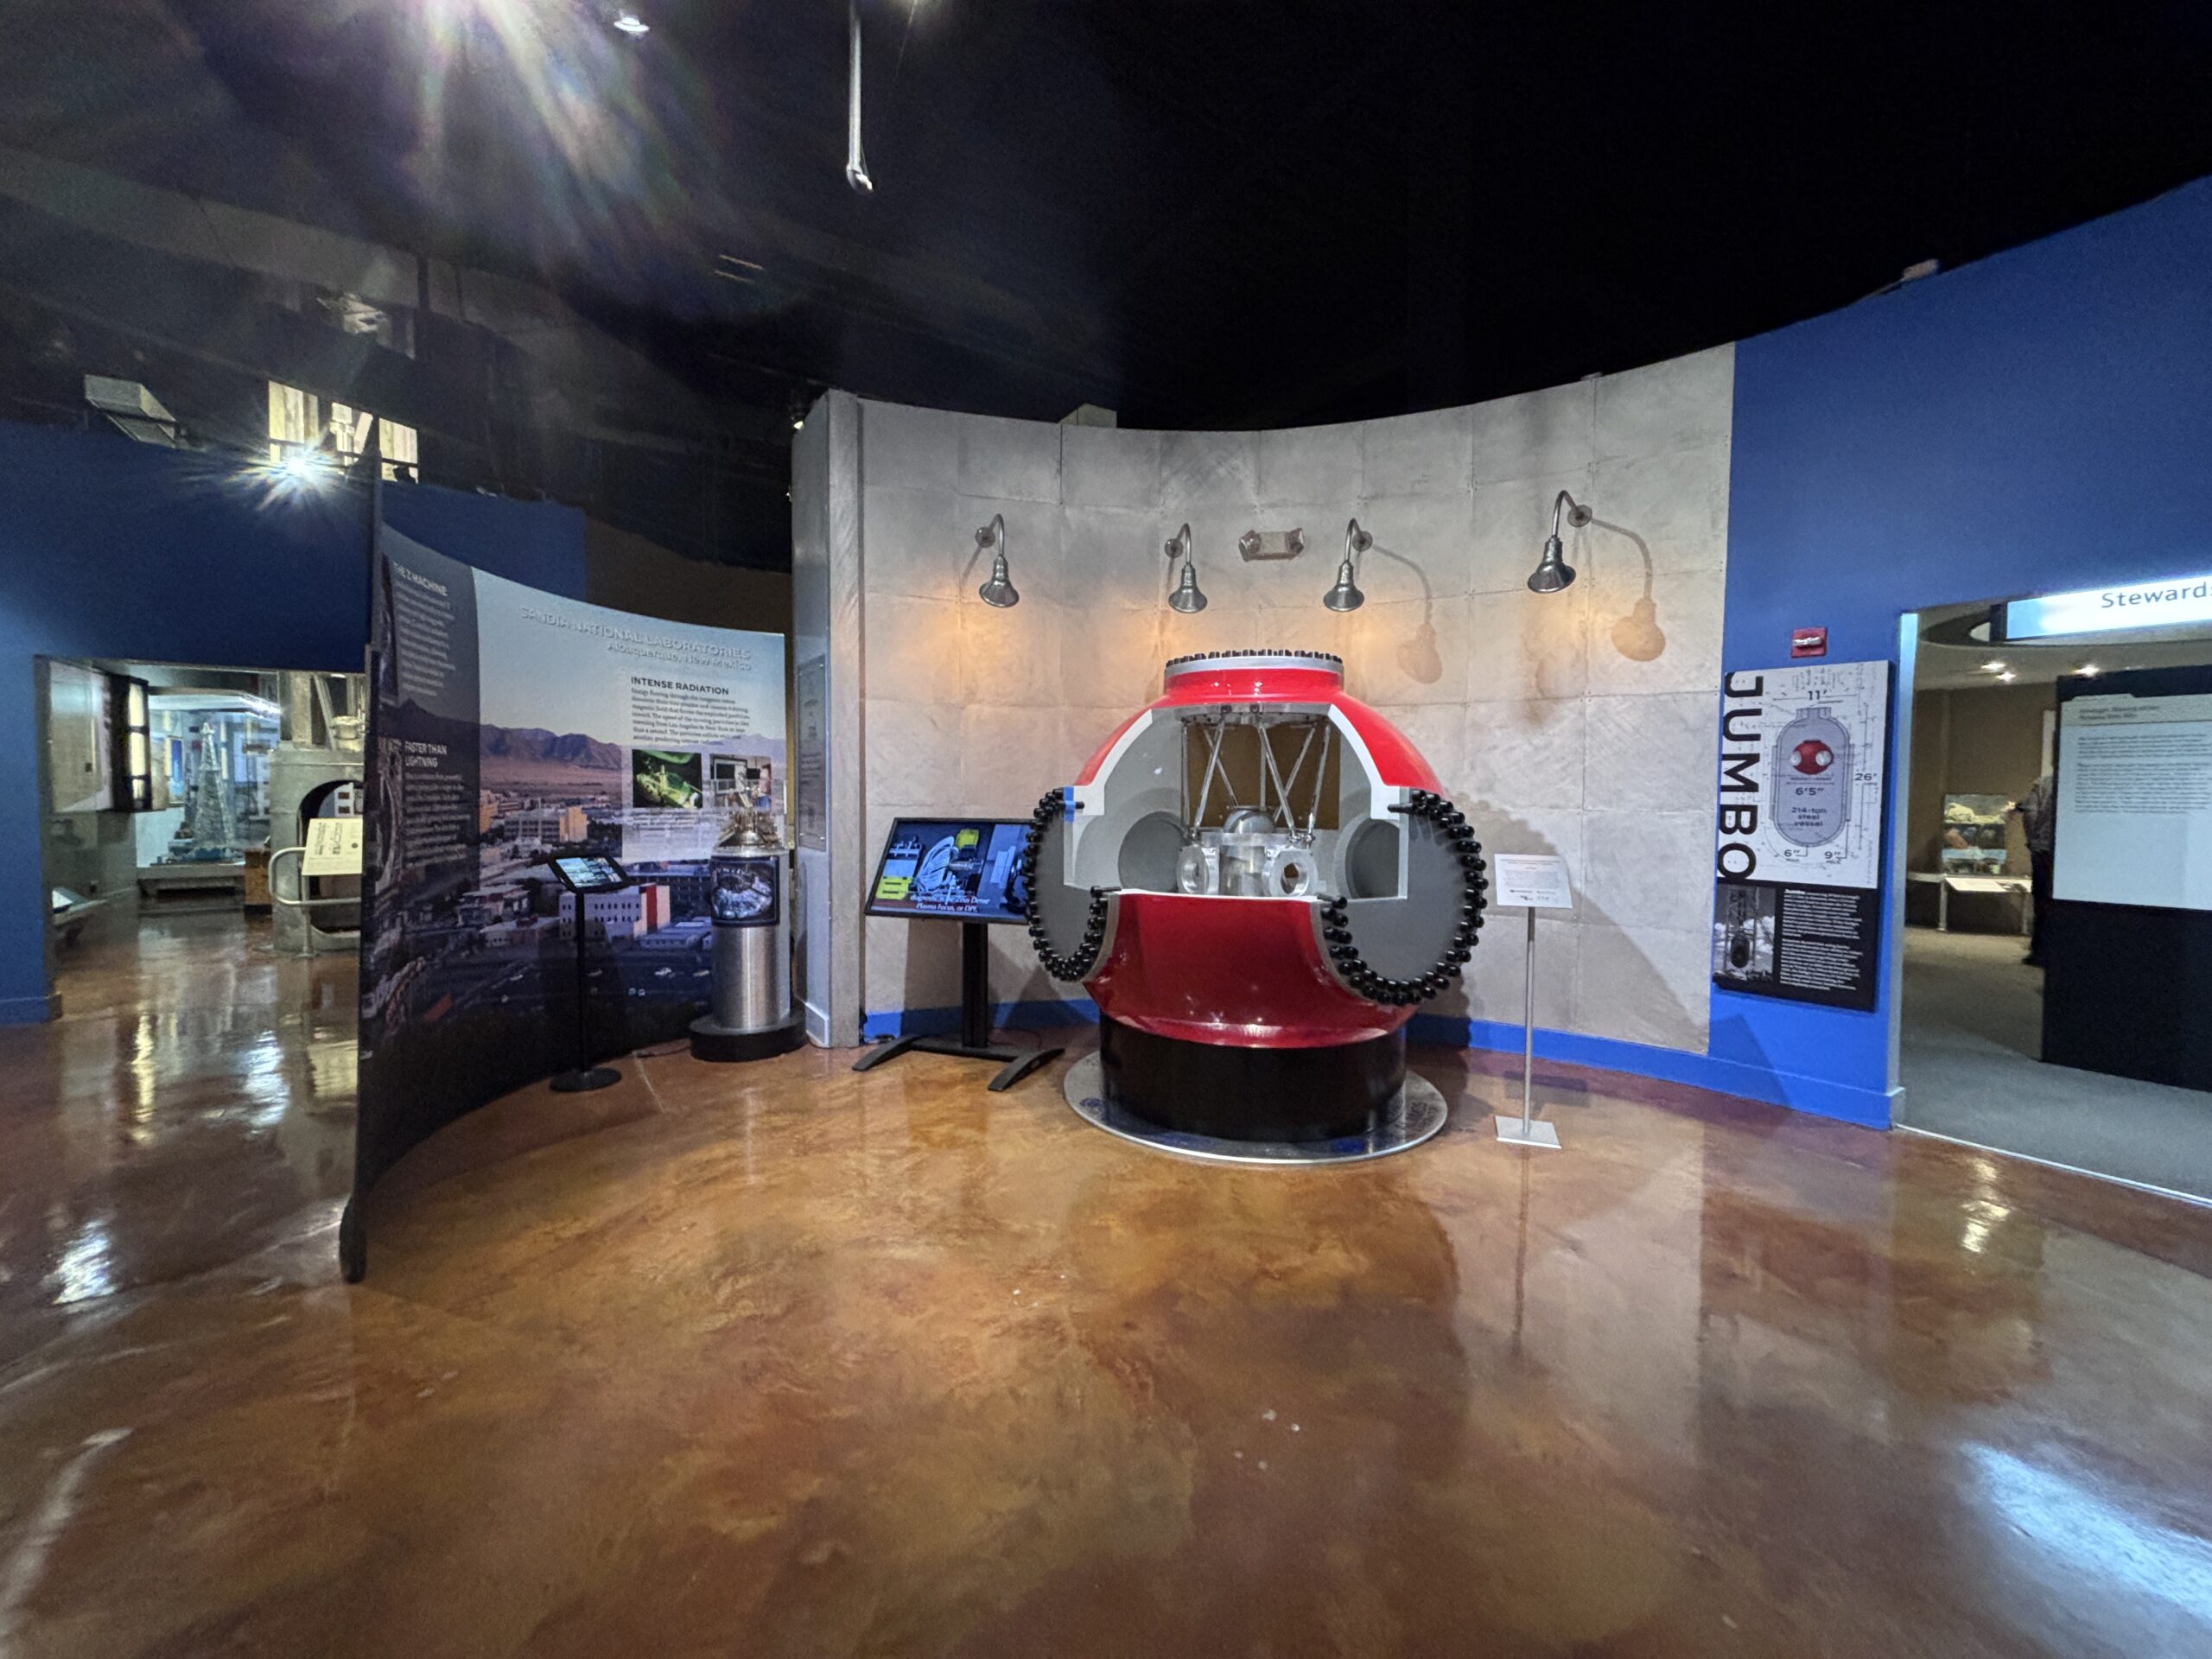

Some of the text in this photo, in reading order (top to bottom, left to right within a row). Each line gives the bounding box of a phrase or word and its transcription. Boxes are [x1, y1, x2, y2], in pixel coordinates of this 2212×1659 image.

[412, 573, 448, 596] MACHINE
[520, 607, 752, 660] SANDIA NATIONAL LABORATORIES
[631, 676, 729, 696] INTENSE RADIATION
[404, 741, 448, 755] FASTER THAN
[404, 755, 439, 768] LIGHTNING
[1718, 671, 1764, 880] JUMBO
[1854, 772, 1878, 781] 26'
